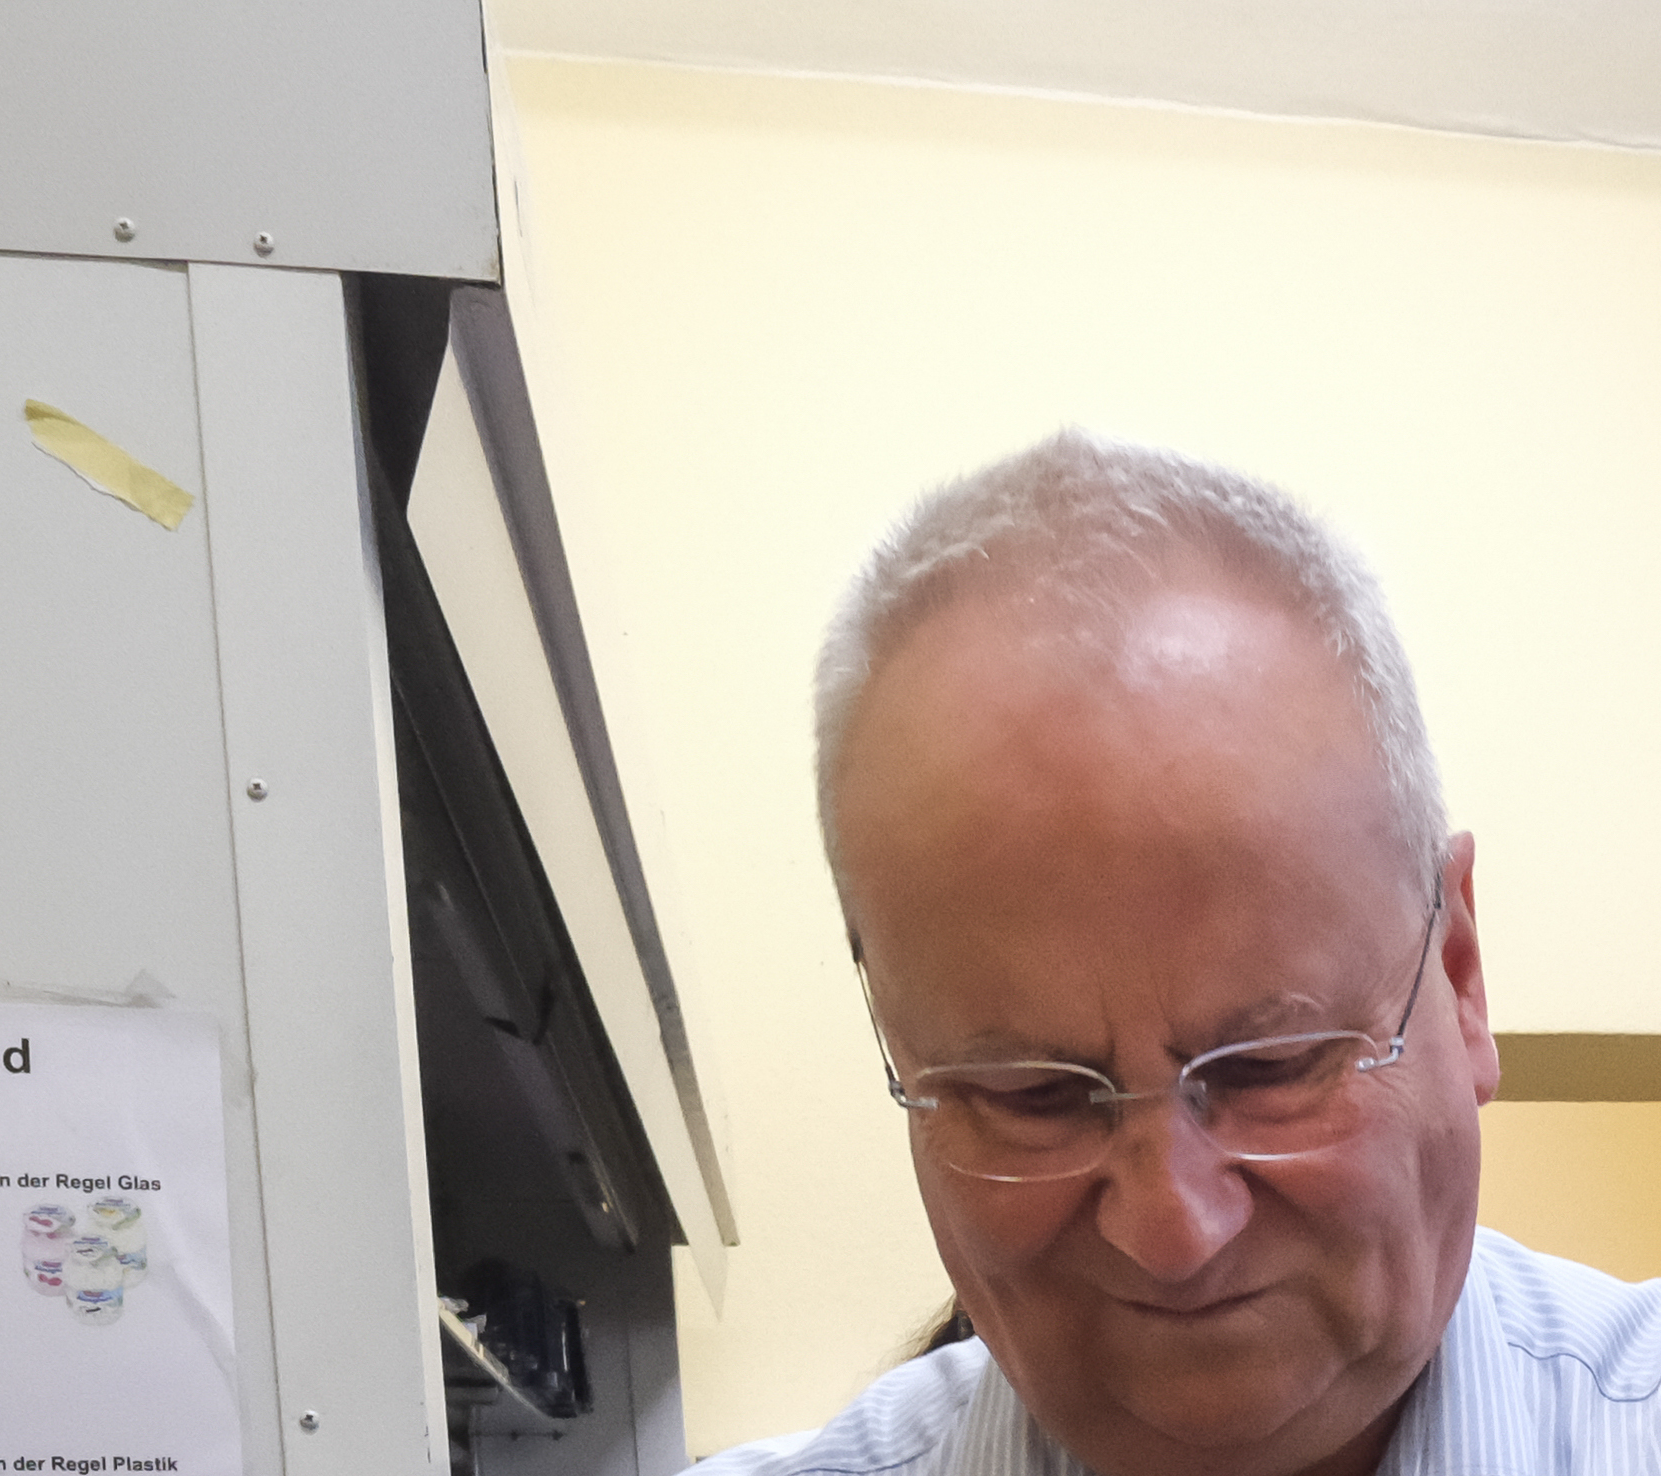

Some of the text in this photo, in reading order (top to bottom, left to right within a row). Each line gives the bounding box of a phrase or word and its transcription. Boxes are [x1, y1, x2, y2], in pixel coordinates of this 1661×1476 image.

[16, 1173, 50, 1188] der
[55, 1173, 112, 1194] Regel
[117, 1175, 162, 1192] Glas
[12, 1456, 46, 1471] der
[51, 1456, 107, 1476] Regel
[112, 1456, 179, 1472] Plastik
